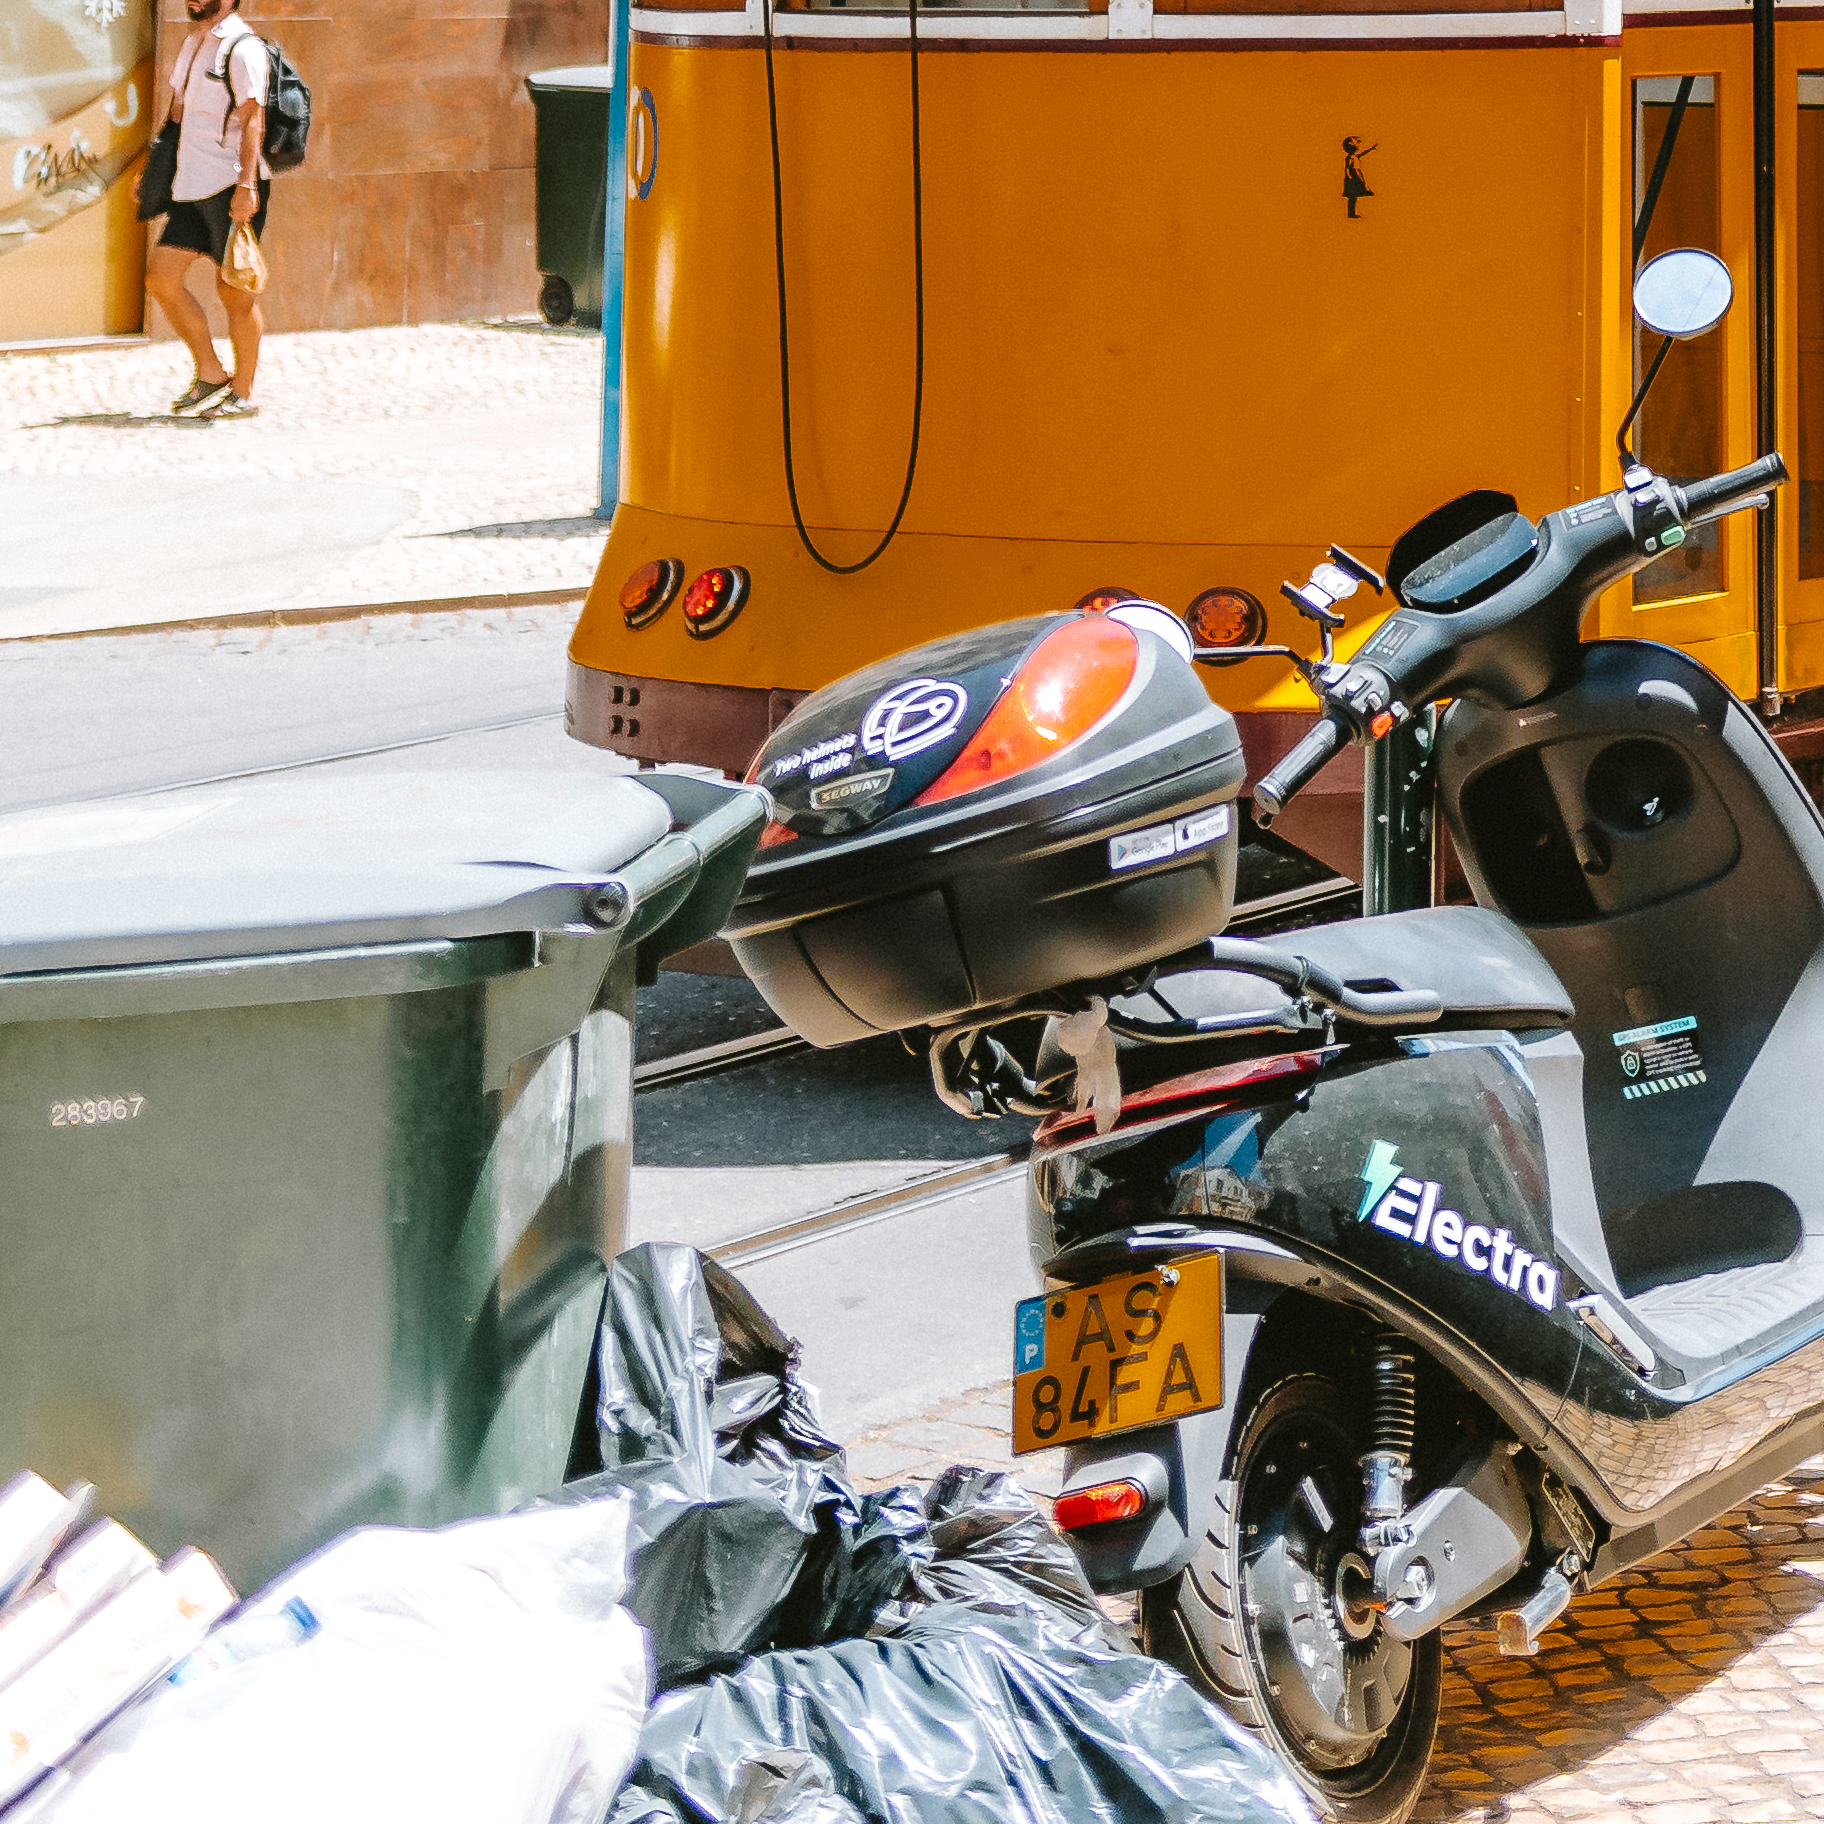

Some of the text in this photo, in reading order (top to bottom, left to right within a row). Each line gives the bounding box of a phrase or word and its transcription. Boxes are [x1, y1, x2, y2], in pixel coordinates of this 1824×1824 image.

[821, 777, 882, 804] SEGWAY
[51, 1095, 145, 1127] 283967
[1371, 1176, 1562, 1314] Electra
[1070, 1281, 1163, 1363] AS
